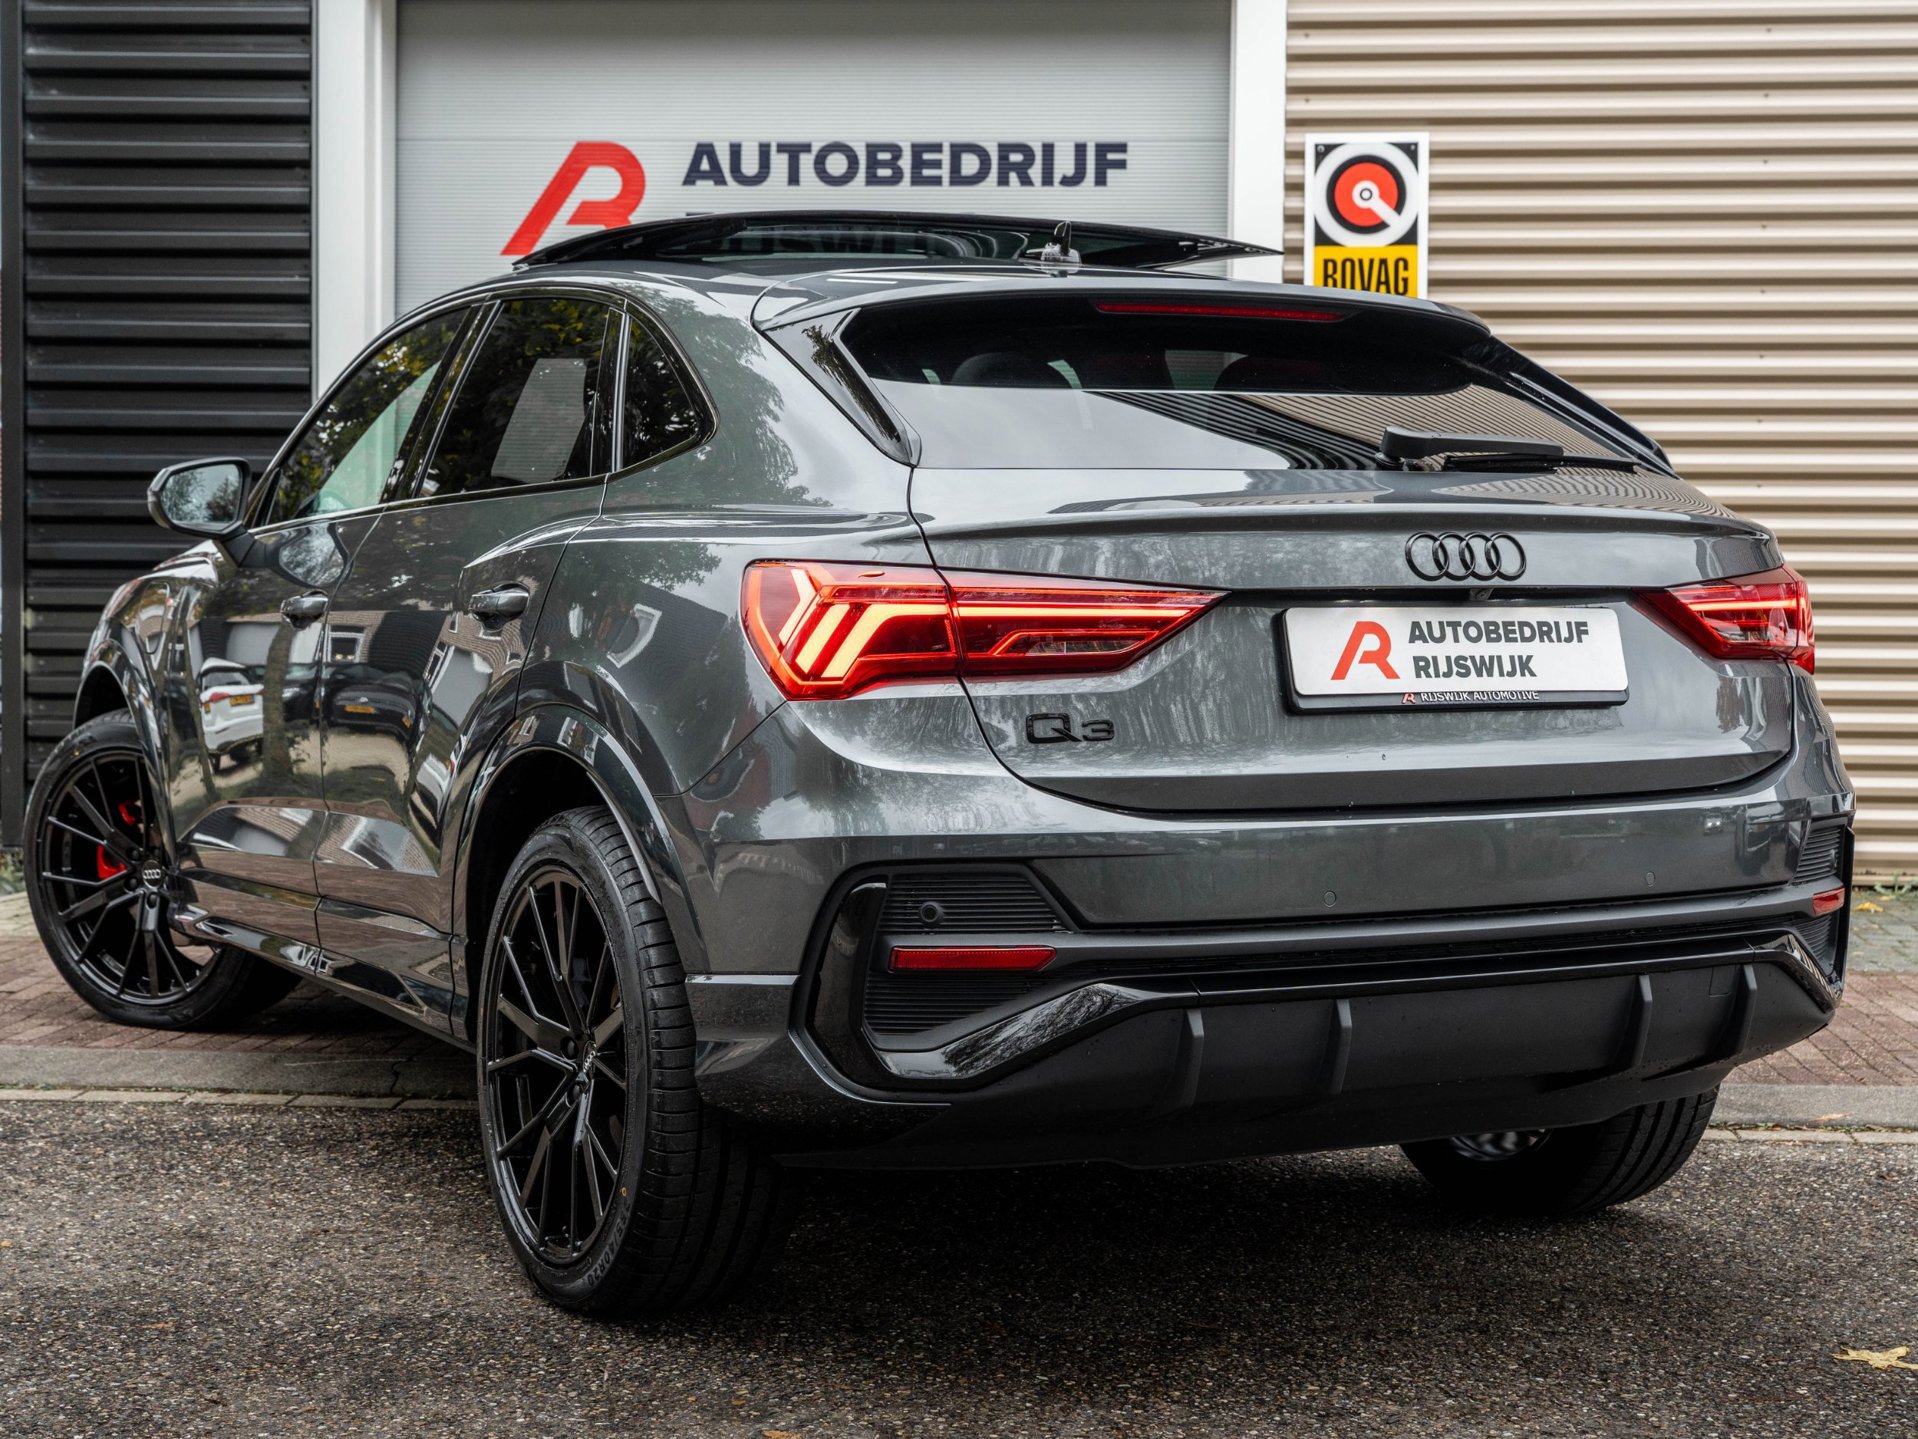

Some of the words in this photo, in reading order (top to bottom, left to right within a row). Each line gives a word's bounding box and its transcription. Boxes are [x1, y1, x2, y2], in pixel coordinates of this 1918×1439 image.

[681, 141, 1129, 188] AUTOBEDRIJF
[1322, 257, 1409, 296] BOVAG
[1408, 620, 1590, 645] AUTOBEDRIJF
[1413, 655, 1537, 679] RIJSWIJK
[1420, 692, 1469, 702] RIJSWIJK
[1473, 690, 1540, 700] AUTOMOTIVE
[1026, 713, 1115, 744] Q3
